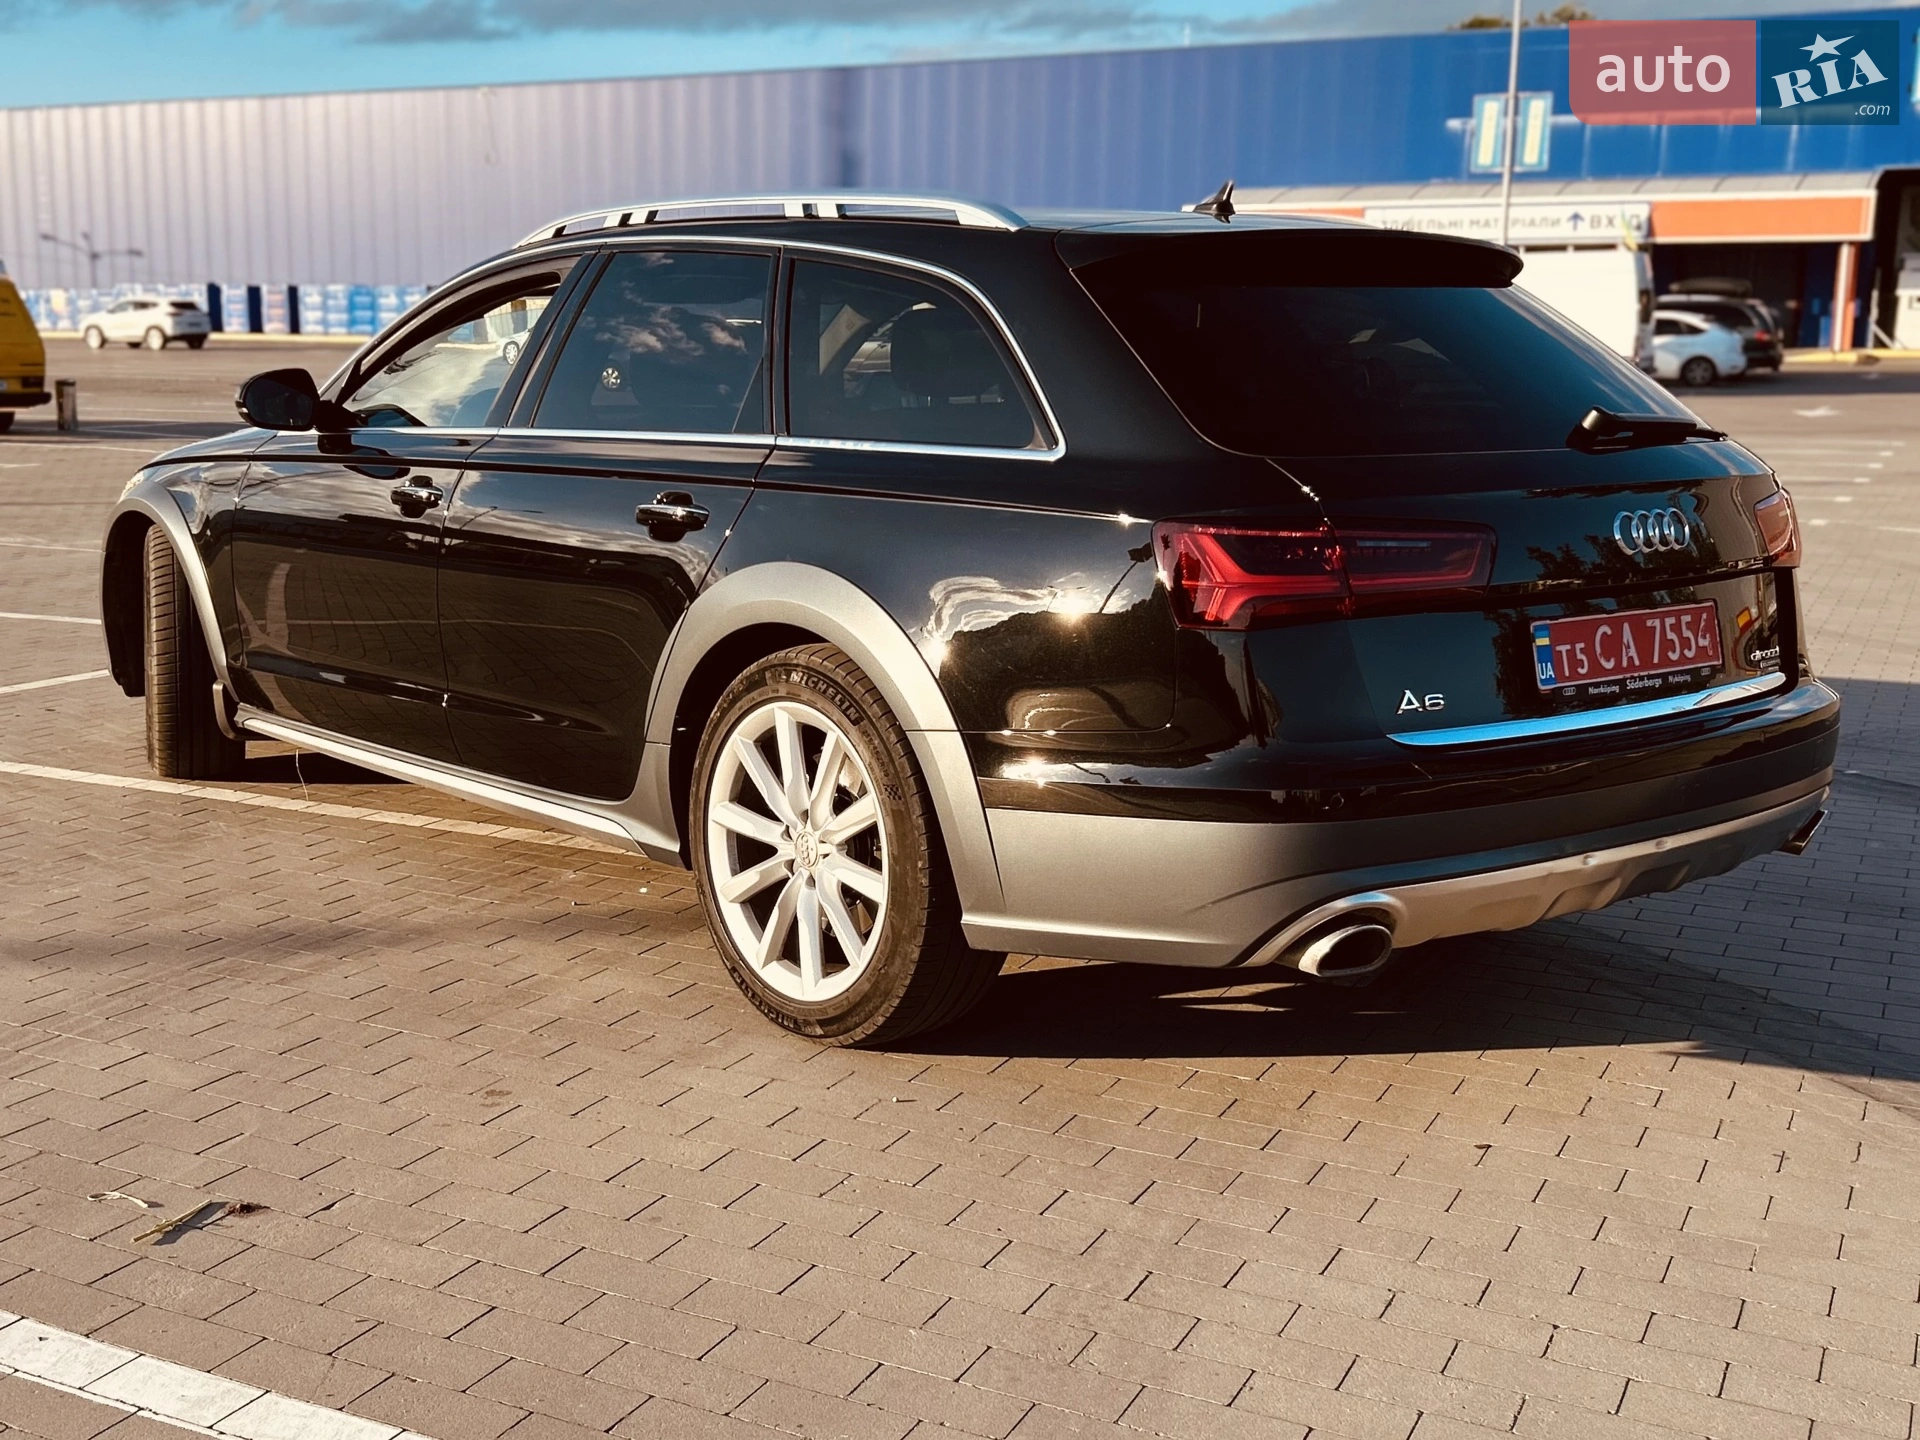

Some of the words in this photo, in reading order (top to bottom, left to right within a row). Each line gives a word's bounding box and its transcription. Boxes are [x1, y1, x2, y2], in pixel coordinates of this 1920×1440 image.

[1469, 215, 1562, 230] МАТРІАЛИ
[1589, 213, 1643, 232] ВХД
[1555, 642, 1589, 677] T5
[1594, 622, 1640, 670] CA
[1646, 612, 1714, 664] 7554
[1538, 662, 1555, 680] UA
[1626, 676, 1663, 690] Söderbergs
[789, 670, 862, 723] MICHELIN
[1397, 689, 1445, 715] A6
